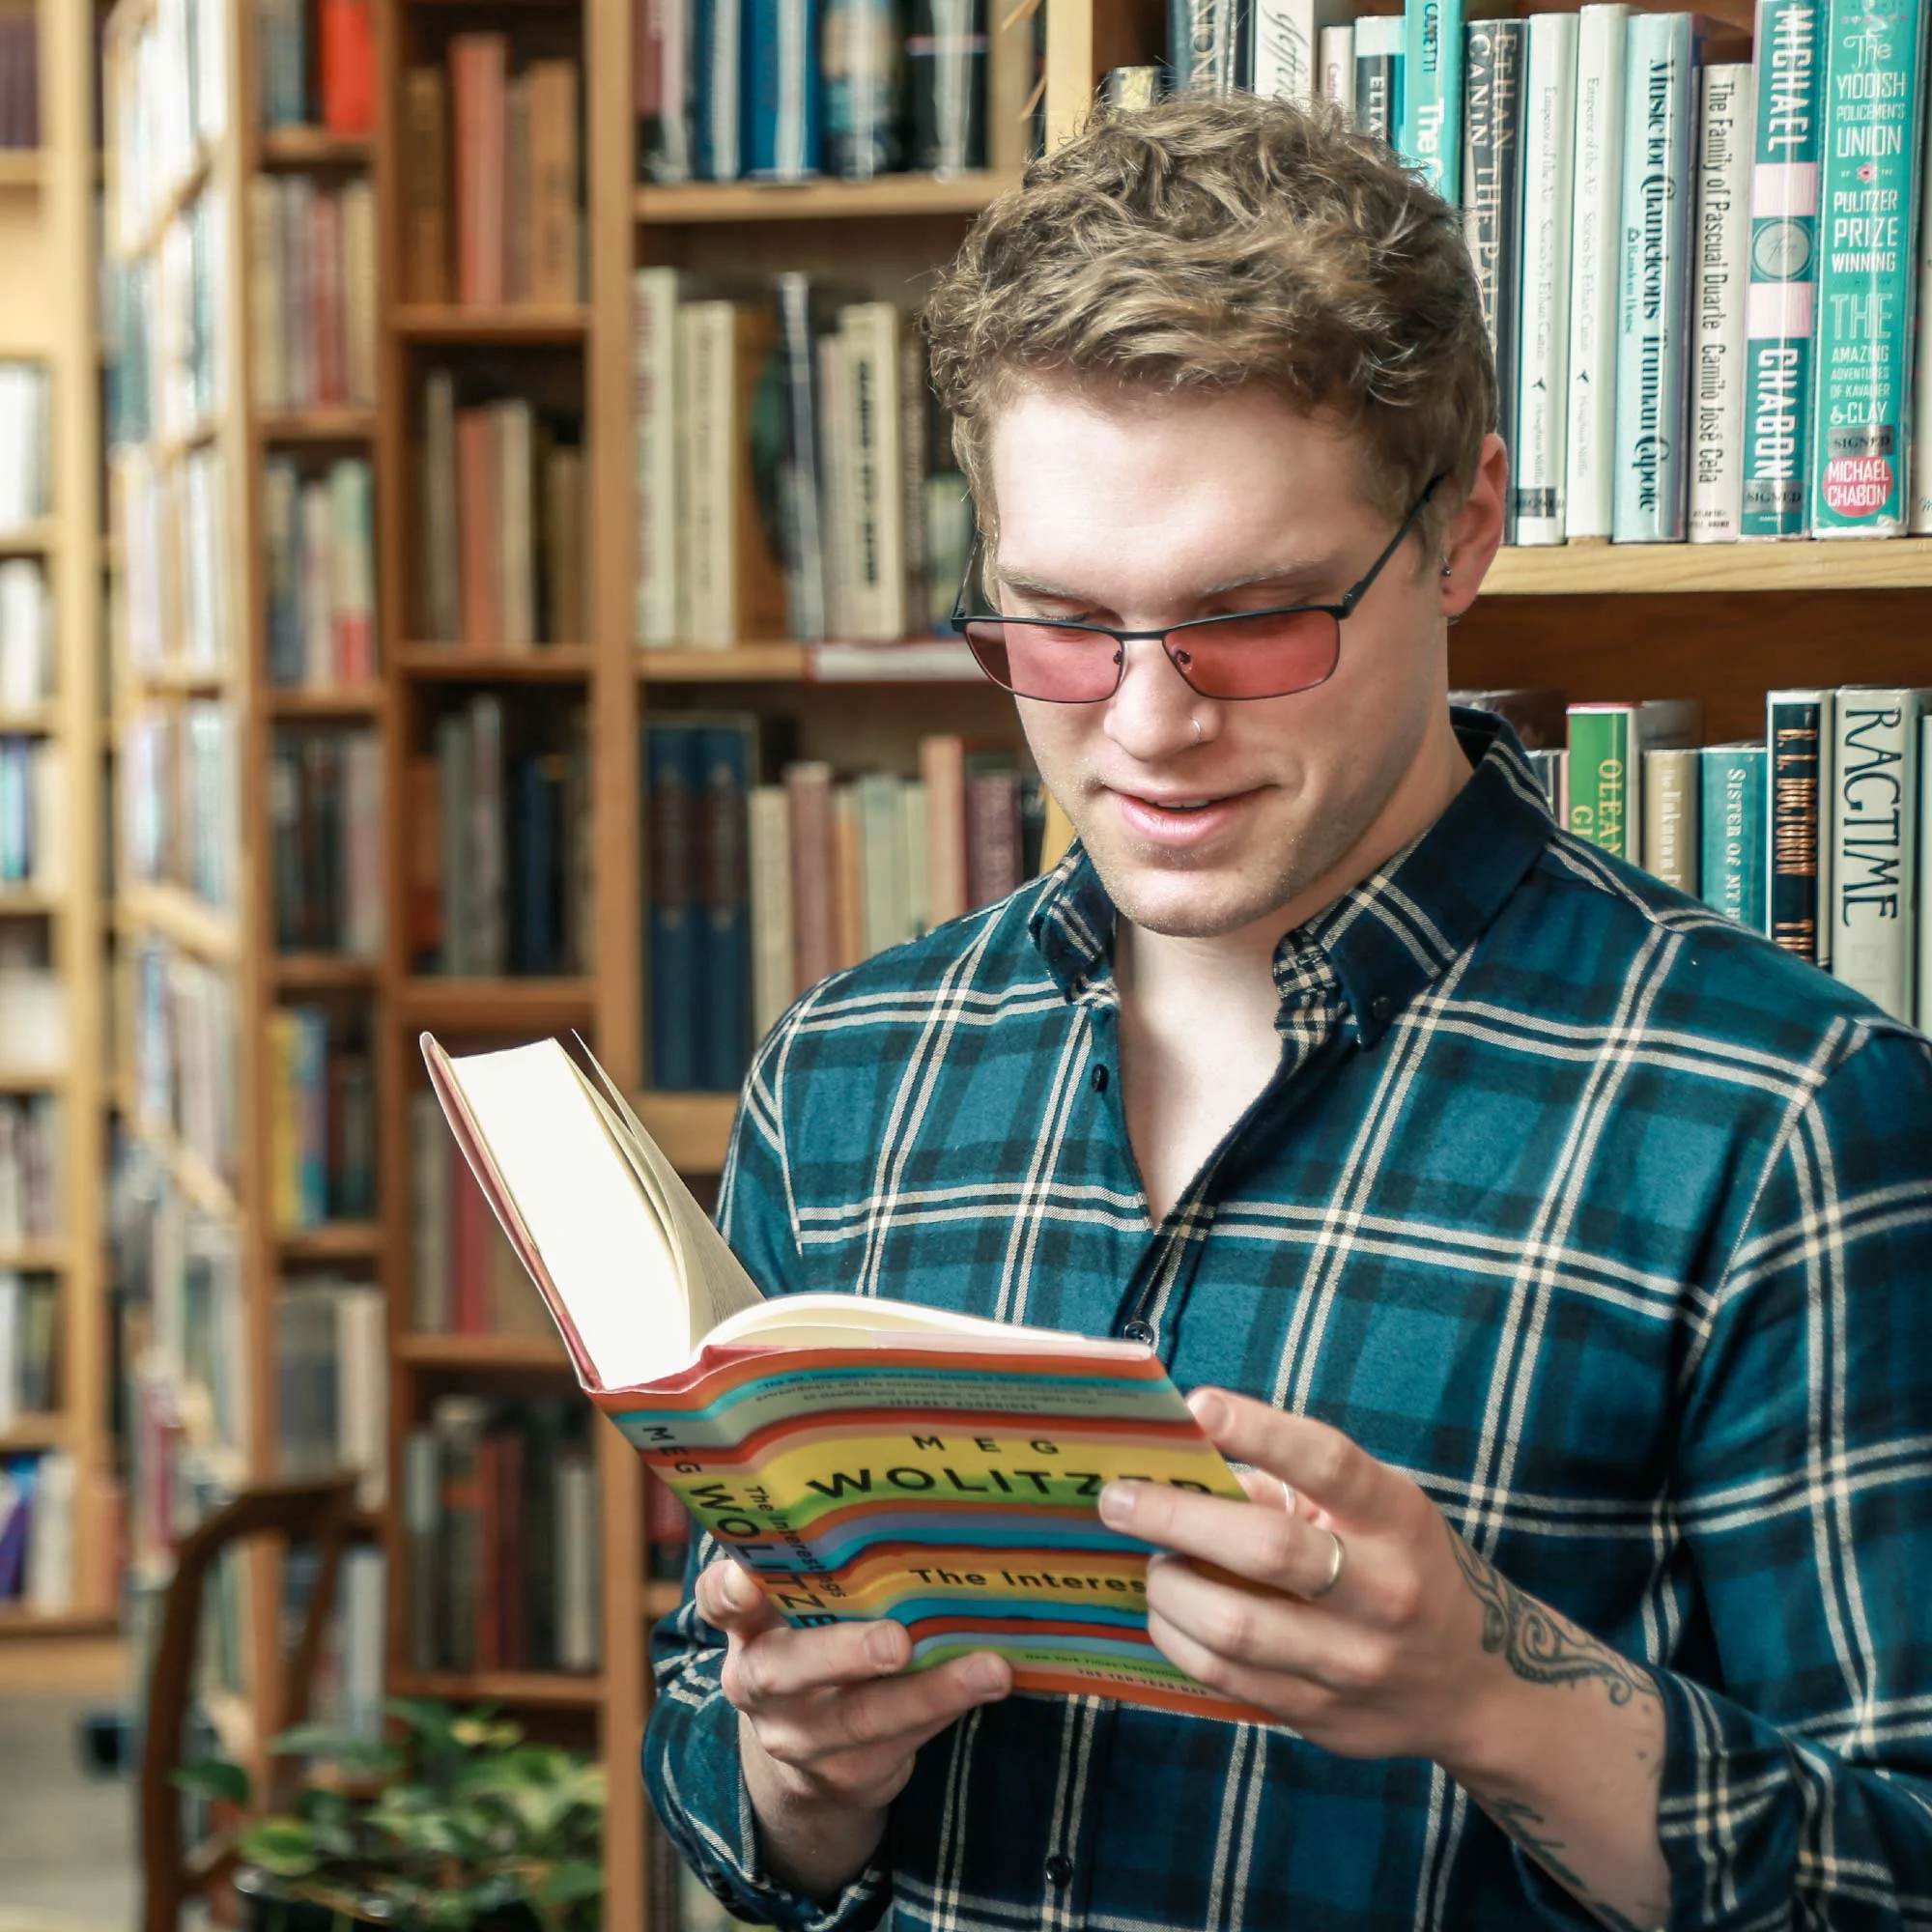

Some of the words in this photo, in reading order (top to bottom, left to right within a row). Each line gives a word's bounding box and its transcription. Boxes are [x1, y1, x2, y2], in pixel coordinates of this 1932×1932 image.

[1422, 3, 1438, 72] CANETTI
[1843, 33, 1892, 70] The
[1469, 34, 1492, 147] CANIN
[1493, 33, 1518, 150] ETHAN
[1648, 59, 1674, 130] Music
[1709, 81, 1734, 111] The
[1768, 9, 1814, 153] MICHAEL
[1836, 71, 1906, 99] YIDDISH
[1369, 76, 1385, 138] ELIA
[1584, 77, 1600, 132] Emperor
[1836, 102, 1905, 122] POLICEMEN'S
[1417, 98, 1444, 153] The
[1836, 125, 1902, 157] UNION
[1584, 136, 1600, 149] of
[1647, 137, 1672, 166] for
[1703, 119, 1733, 172] Family
[1476, 162, 1501, 225] THE
[1707, 179, 1730, 197] of
[1833, 189, 1898, 213] PULITZER
[1641, 174, 1676, 320] Chameleons
[1703, 201, 1730, 268] Pascual
[1833, 216, 1899, 248] PRIZE
[1832, 252, 1896, 273] WINNING
[1702, 273, 1728, 329] Duarte
[1830, 293, 1893, 339] THE
[1832, 345, 1889, 363] AMAZING
[1640, 330, 1669, 430] Truman
[1701, 344, 1726, 399] Camilo
[1831, 366, 1889, 381] ADVENTURES
[1831, 384, 1843, 399] OF
[1846, 383, 1890, 397] KAVALIER
[1699, 408, 1724, 440] José
[1754, 348, 1799, 478] CHABON
[1848, 400, 1888, 423] CLAY
[1834, 435, 1890, 448] SIGNED
[1632, 435, 1670, 512] Capote
[1698, 449, 1723, 483] Cela
[1828, 459, 1889, 483] MICHAEL
[1747, 491, 1803, 502] SIGNED
[1828, 484, 1887, 506] CHABON
[1776, 753, 1817, 771] L.
[1776, 778, 1816, 876] DOCTOROW
[1843, 708, 1903, 926] RAGTIME
[1776, 919, 1814, 960] TH
[744, 1485, 774, 1512] The
[807, 1467, 1212, 1499] WOLITZ
[643, 1427, 701, 1473] MEG
[689, 1485, 838, 1630] WOLITZE
[910, 1569, 988, 1586] The
[1077, 1668, 1102, 1678] THE
[1109, 1673, 1175, 1690] TEN-YEAR
